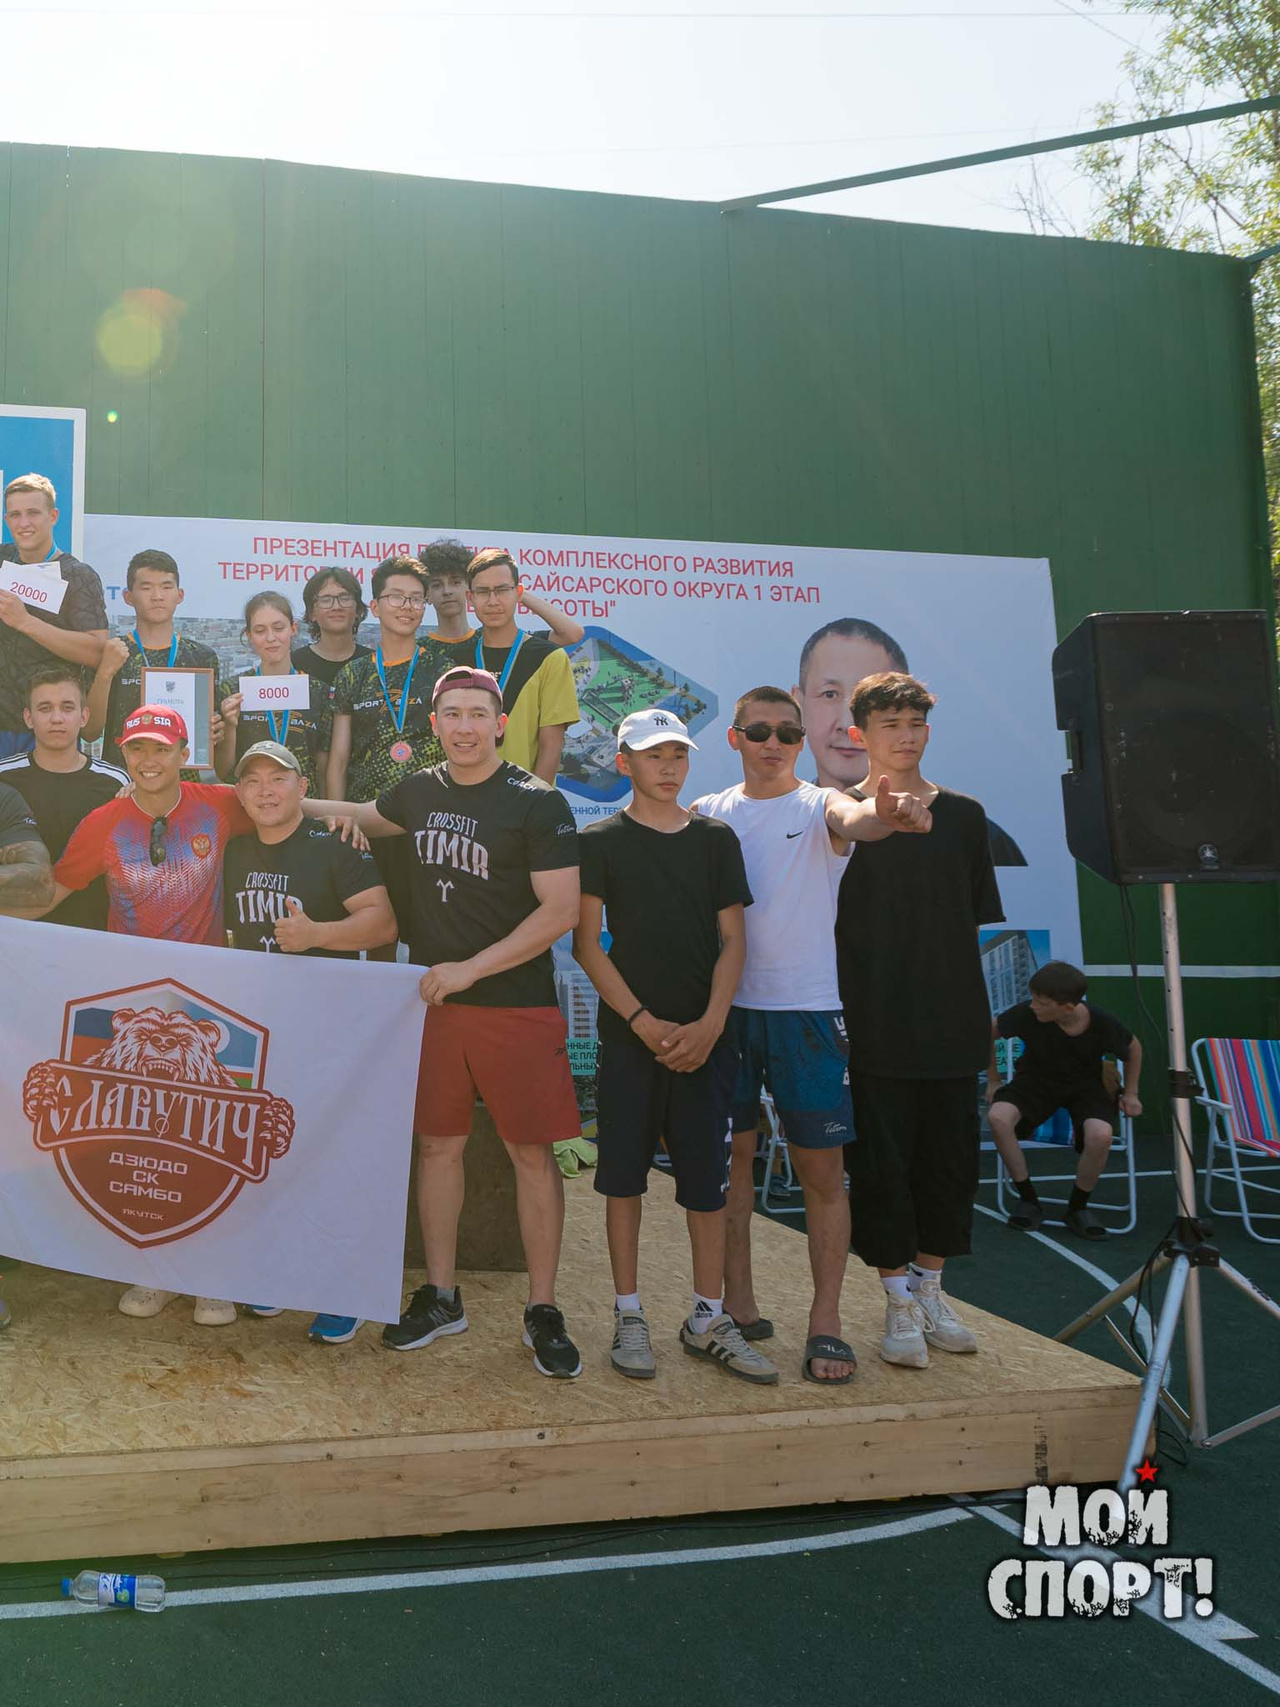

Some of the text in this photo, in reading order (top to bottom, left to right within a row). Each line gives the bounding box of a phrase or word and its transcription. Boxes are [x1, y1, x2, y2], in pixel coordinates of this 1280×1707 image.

[253, 537, 410, 562] ПРЕЗЕНТАЦИЯ
[520, 549, 687, 572] КОМПЛЕКСНОГО
[693, 557, 794, 577] РАЗВИТИЯ
[10, 581, 48, 603] 20000
[218, 562, 364, 584] ТЕРРИТОИ
[520, 572, 667, 596] САЙСАРСКОГО
[673, 581, 749, 600] ОКРУГА
[754, 585, 762, 600] 1
[770, 585, 820, 603] ЭТАП
[259, 687, 289, 699] 8000
[507, 777, 538, 792] COACH
[570, 806, 600, 815] ЕННОЙ
[426, 811, 478, 838] CROSSFIT
[414, 830, 489, 880] TIMIR
[245, 871, 289, 892] CROSSFIT
[109, 1151, 188, 1175] ДЗЮДО
[133, 1170, 160, 1186] СК
[122, 1208, 164, 1221] ЯКУТСК
